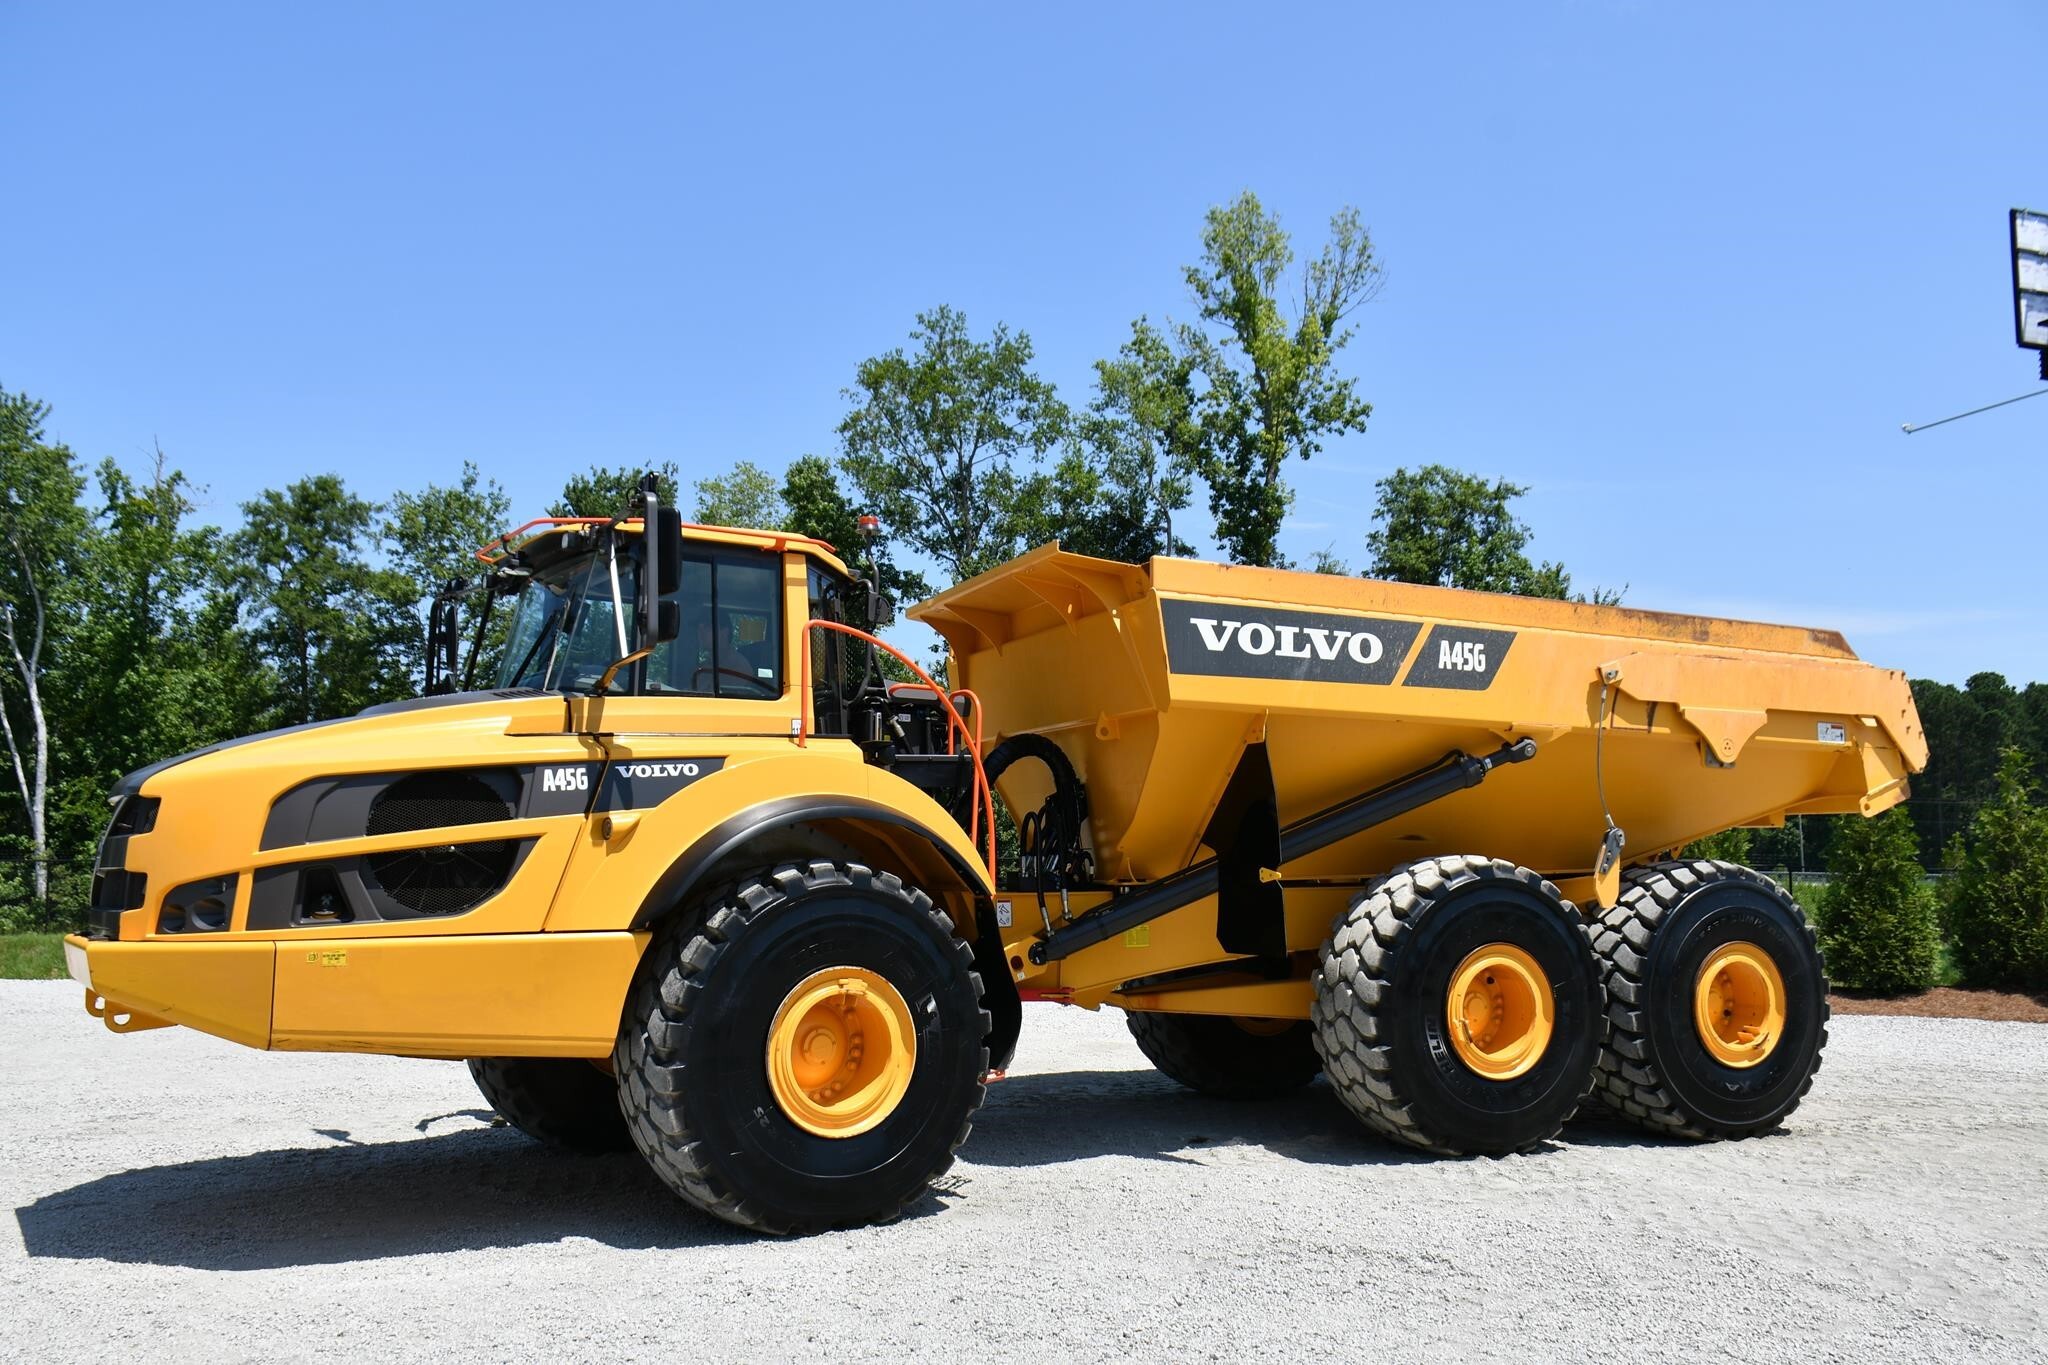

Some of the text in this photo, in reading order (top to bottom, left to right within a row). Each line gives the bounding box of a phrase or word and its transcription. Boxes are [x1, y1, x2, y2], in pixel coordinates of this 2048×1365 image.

[1190, 618, 1383, 664] VOLVO
[1438, 640, 1486, 672] A45G
[543, 767, 588, 791] A45G
[615, 763, 699, 778] VOLVO
